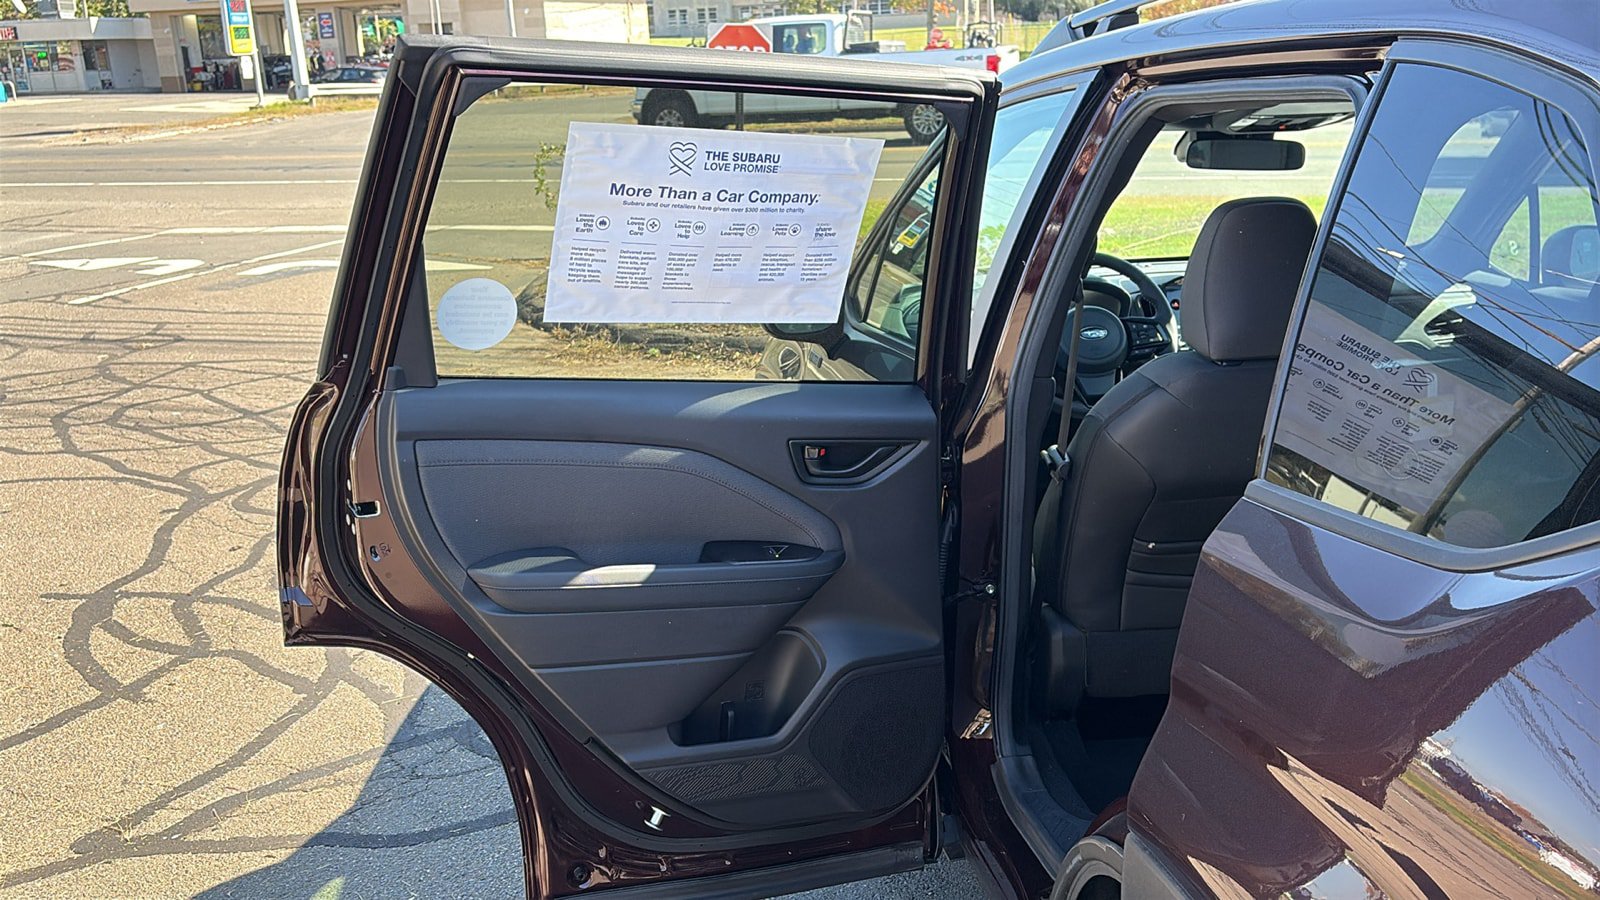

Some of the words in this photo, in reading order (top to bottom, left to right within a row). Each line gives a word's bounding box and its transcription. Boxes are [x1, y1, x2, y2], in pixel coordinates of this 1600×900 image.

[705, 151, 729, 162] THE
[732, 152, 781, 164] SUBARU
[704, 162, 731, 172] LOVE
[733, 163, 779, 174] PROMISE
[610, 182, 652, 198] More
[658, 186, 698, 200] Than
[702, 191, 712, 202] a
[717, 189, 744, 202] Car
